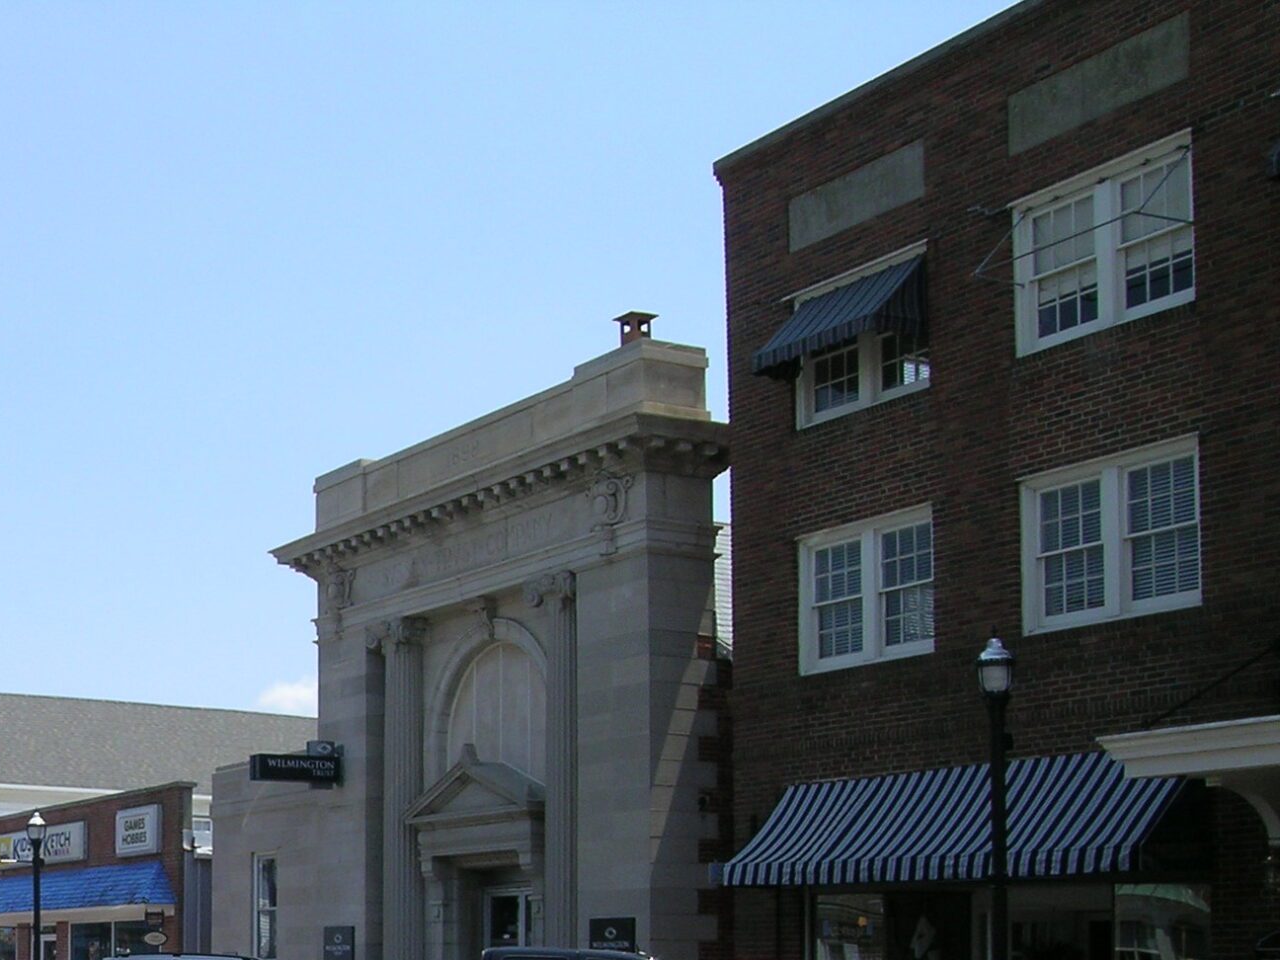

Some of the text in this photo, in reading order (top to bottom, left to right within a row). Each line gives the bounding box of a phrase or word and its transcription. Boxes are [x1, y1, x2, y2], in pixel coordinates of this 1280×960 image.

[267, 758, 335, 769] WILMINGTON
[124, 818, 145, 832] GAMES
[43, 831, 71, 857] KETCH
[122, 831, 147, 845] HOBBIES
